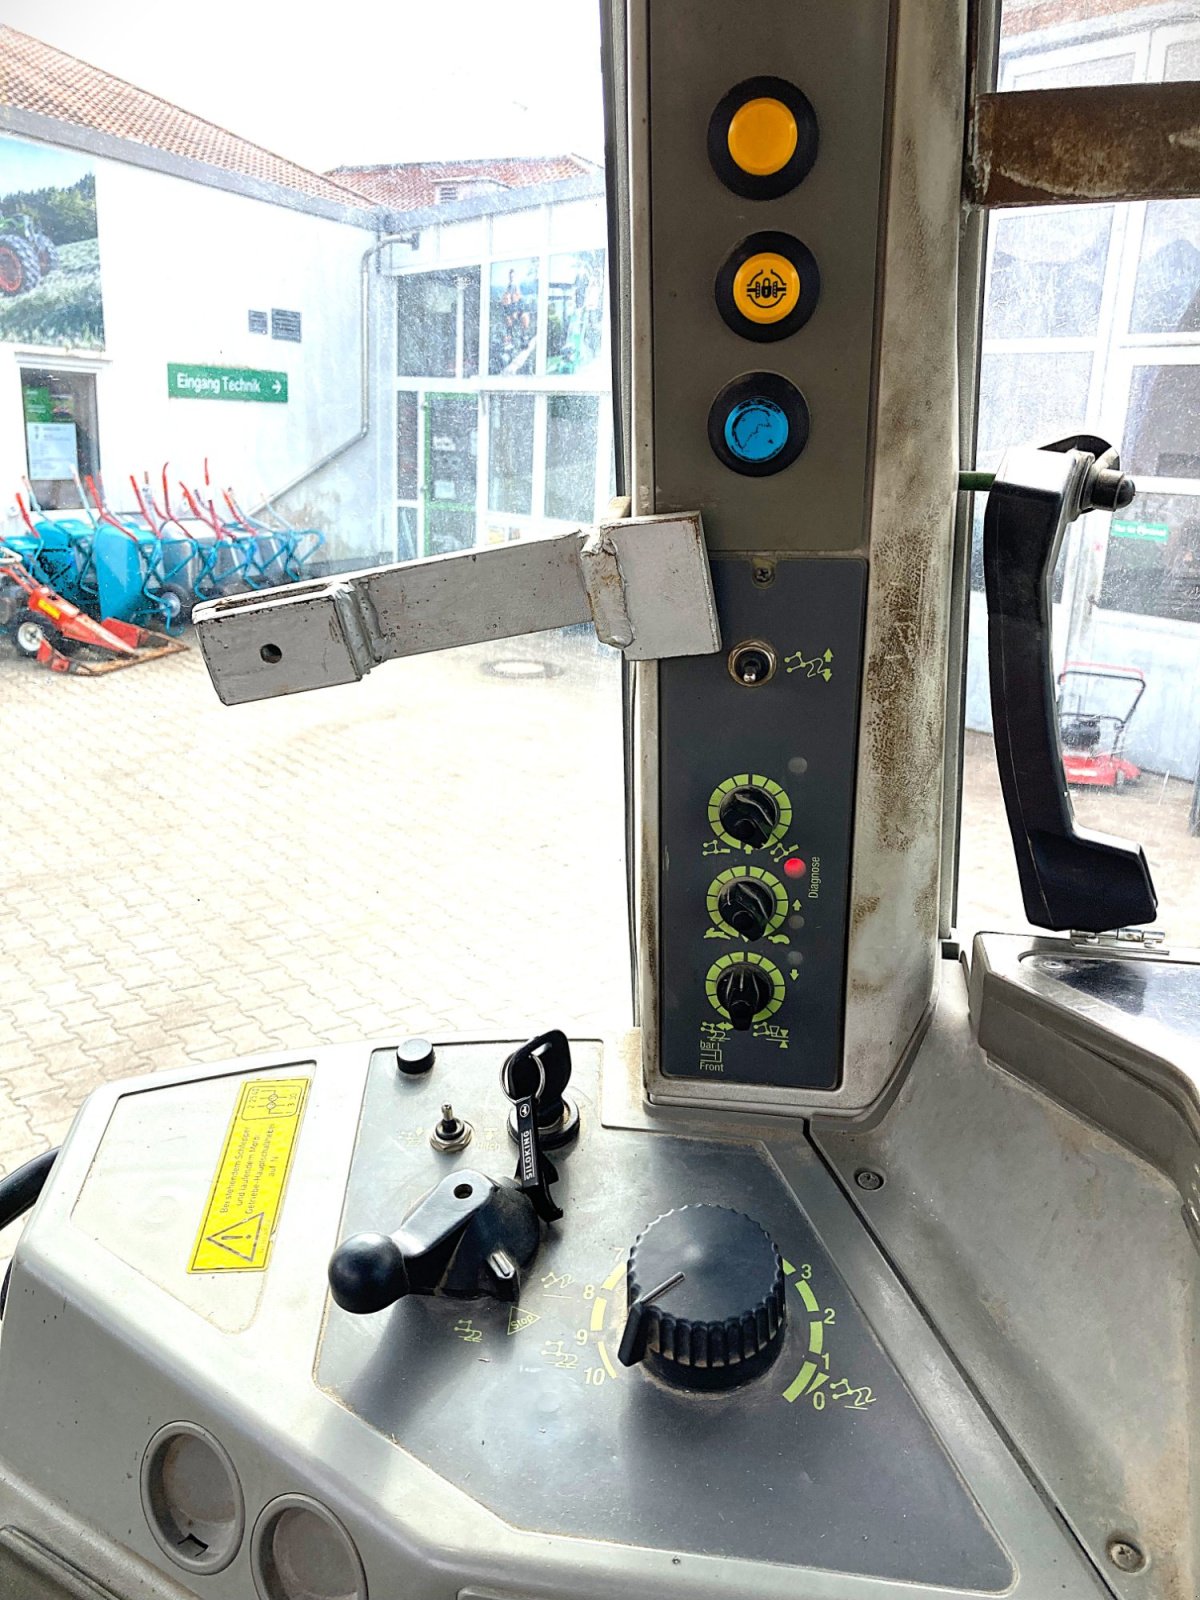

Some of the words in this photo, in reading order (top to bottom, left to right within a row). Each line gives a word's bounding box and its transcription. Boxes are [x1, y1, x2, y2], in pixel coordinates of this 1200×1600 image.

[177, 372, 221, 394] Eingang
[221, 376, 261, 393] Technik
[808, 856, 822, 899] Diagnose
[699, 1039, 716, 1049] bar
[699, 1061, 724, 1073] Front
[523, 1130, 534, 1180] SILOKING
[225, 1160, 241, 1200] stehendem
[614, 1247, 625, 1261] 7
[801, 1264, 812, 1280] 3
[583, 1284, 595, 1299] 8
[510, 1314, 534, 1330] Stop
[823, 1308, 836, 1325] 2
[576, 1328, 588, 1345] 9
[821, 1352, 830, 1370] 1
[583, 1367, 606, 1386] 10
[813, 1391, 825, 1410] 0
